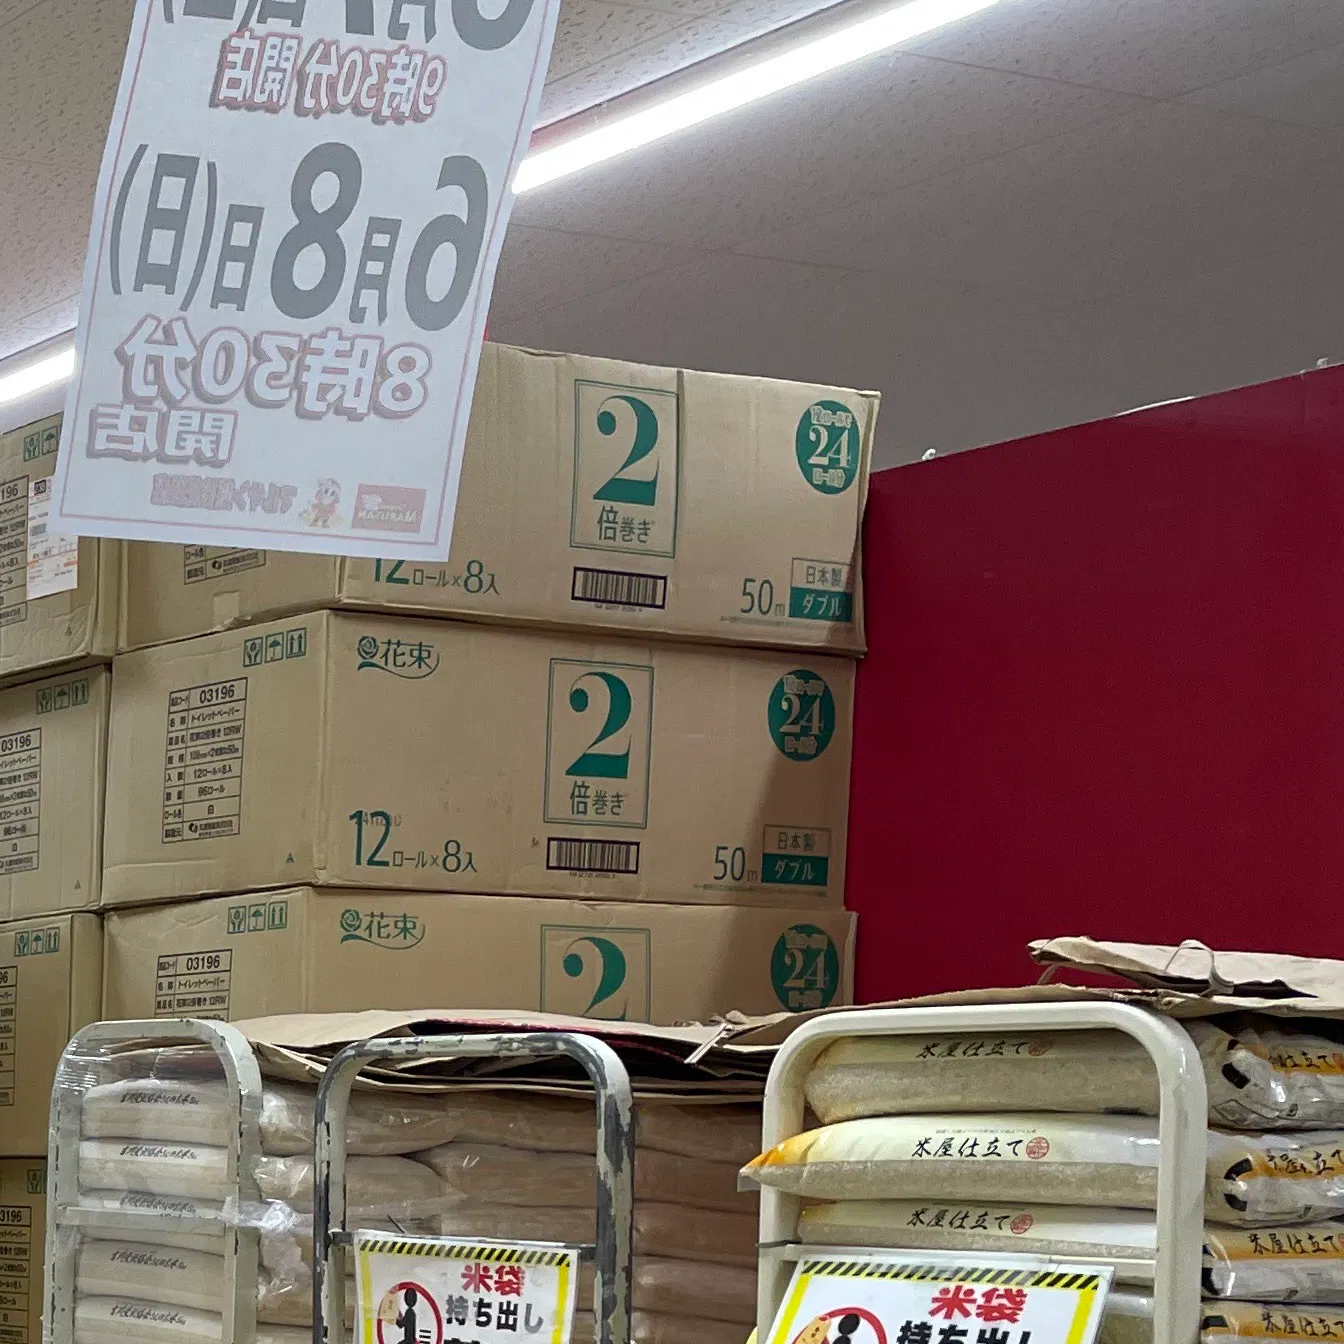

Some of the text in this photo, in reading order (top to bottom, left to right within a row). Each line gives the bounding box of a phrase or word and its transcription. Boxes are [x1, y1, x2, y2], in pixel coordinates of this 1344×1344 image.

[808, 426, 851, 468] 24
[597, 505, 656, 545] 倍巻き
[803, 593, 844, 617] ダブル
[380, 638, 434, 670] 花束
[199, 686, 235, 704] 03196
[780, 694, 824, 735] 24
[2, 735, 31, 752] 03196
[570, 780, 625, 816] 倍巻き
[349, 810, 477, 873] 12ロール×8入
[362, 912, 420, 942] 花束
[784, 951, 829, 988] 24
[912, 1134, 1023, 1161] 米屋仕立て
[906, 1207, 1010, 1233] 米屋仕立て
[461, 1262, 526, 1297] 米袋
[446, 1294, 543, 1333] 持ち出し
[928, 1283, 1028, 1325] 米袋
